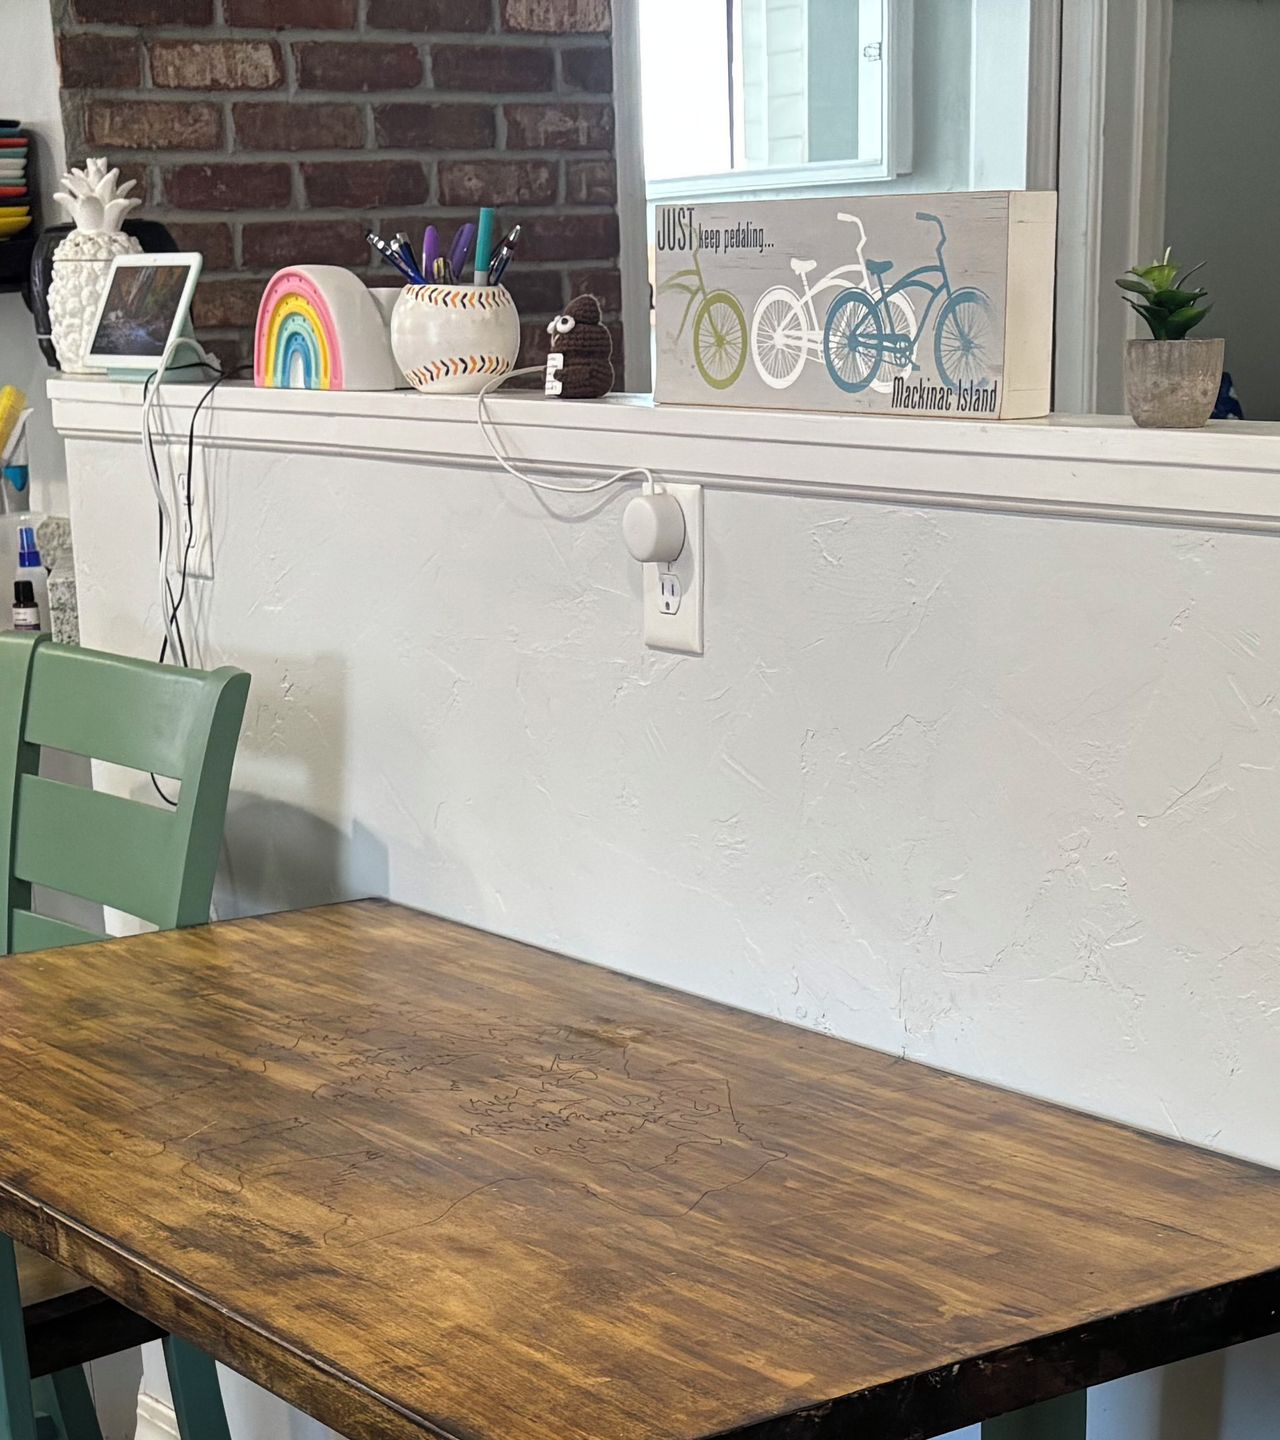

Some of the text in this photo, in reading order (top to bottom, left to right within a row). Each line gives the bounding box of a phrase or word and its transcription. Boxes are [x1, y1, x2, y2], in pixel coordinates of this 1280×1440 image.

[657, 207, 774, 254] JUST keep pedaling...
[891, 376, 998, 413] Mackinac Island
